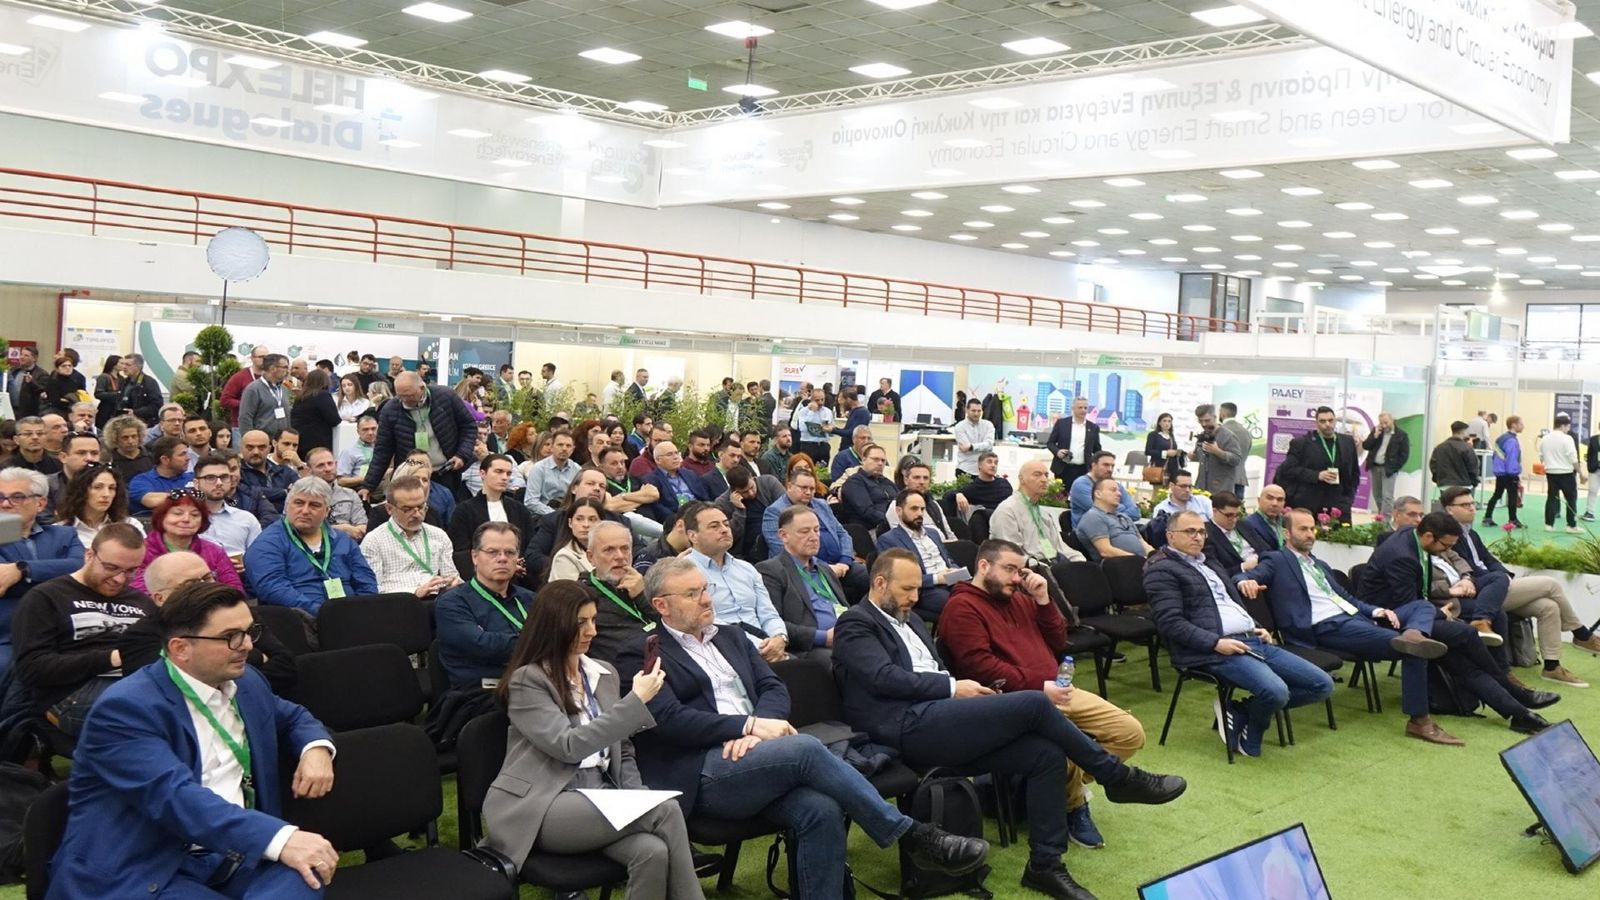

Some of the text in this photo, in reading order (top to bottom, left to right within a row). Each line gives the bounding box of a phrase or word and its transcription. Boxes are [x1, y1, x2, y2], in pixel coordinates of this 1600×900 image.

[1428, 19, 1452, 50] and
[1455, 26, 1499, 72] Circuar
[1502, 51, 1552, 106] Economy
[433, 351, 459, 361] BAAN
[73, 600, 146, 617] NEW YORK
